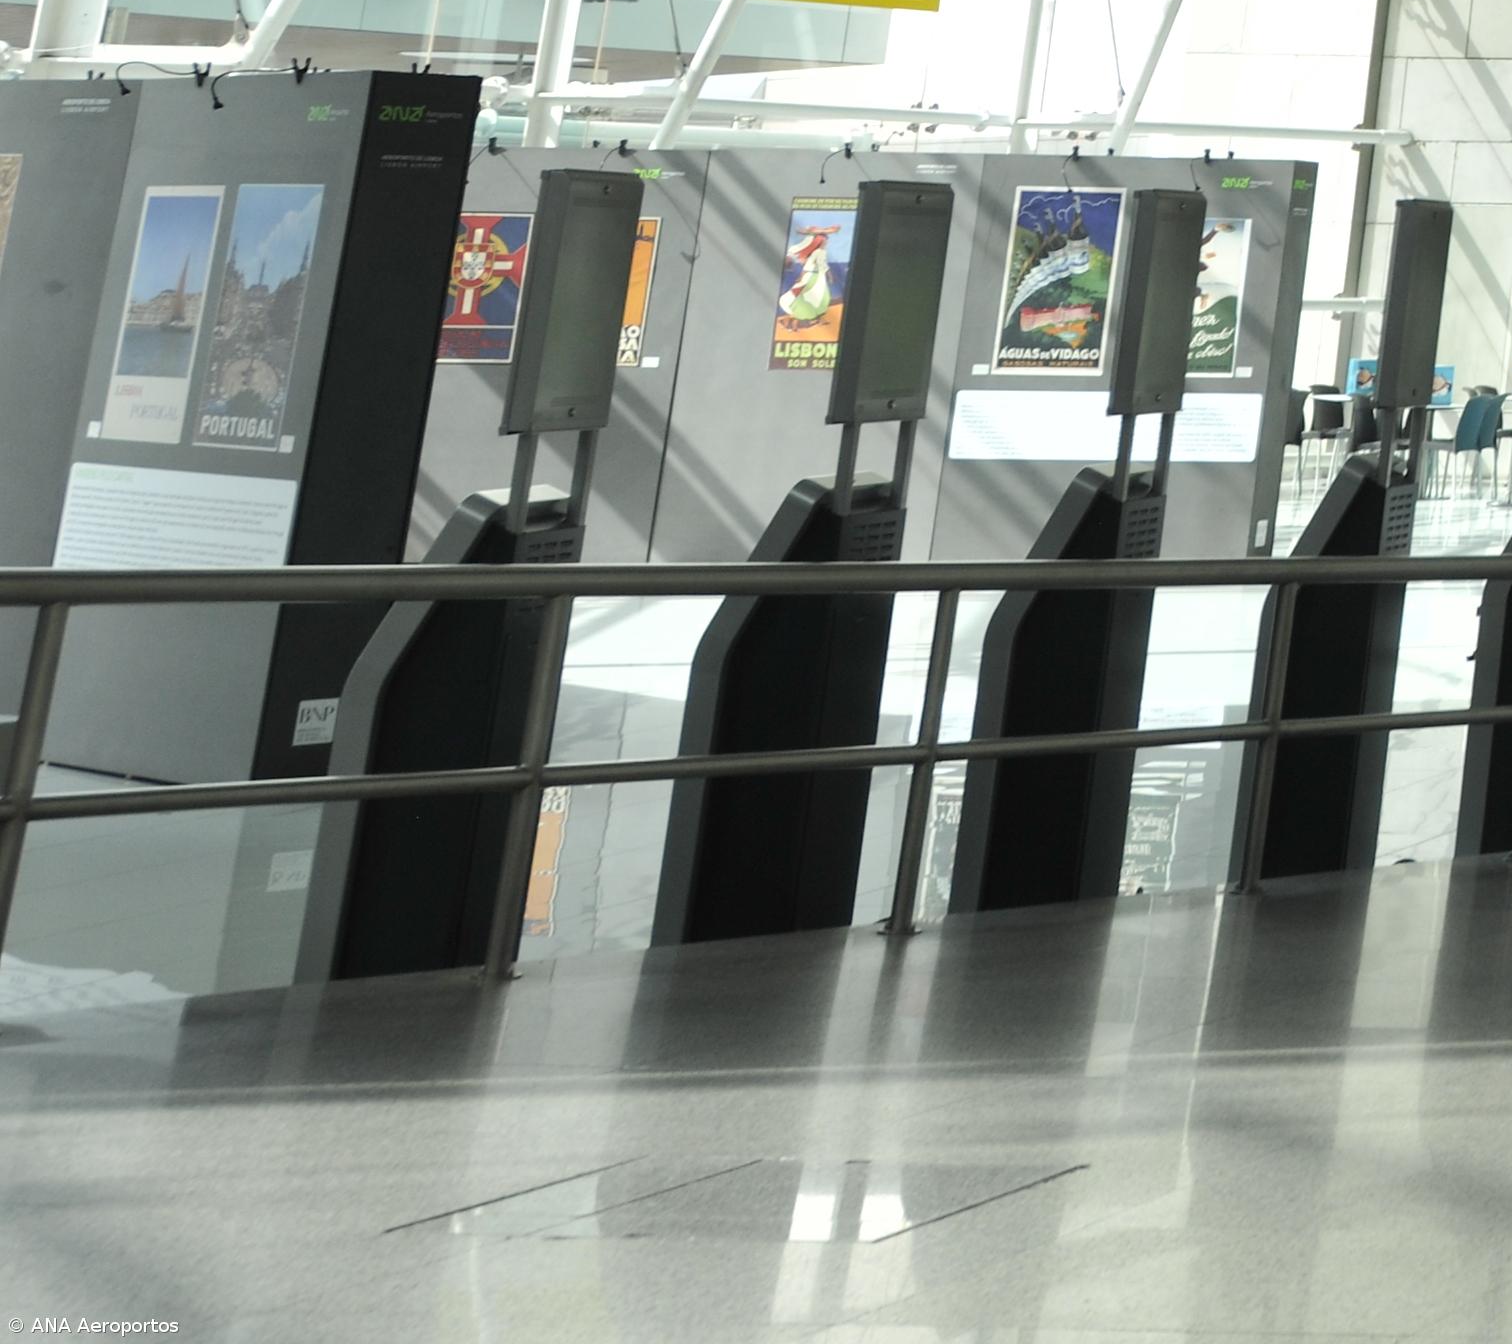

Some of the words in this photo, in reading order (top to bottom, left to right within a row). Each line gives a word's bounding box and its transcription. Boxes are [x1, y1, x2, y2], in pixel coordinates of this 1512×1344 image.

[774, 342, 839, 359] LISBON
[998, 345, 1041, 360] ÁGUAS
[1050, 347, 1100, 361] VIDAGO
[811, 359, 836, 368] SOLE
[200, 414, 275, 439] PORTUGAL
